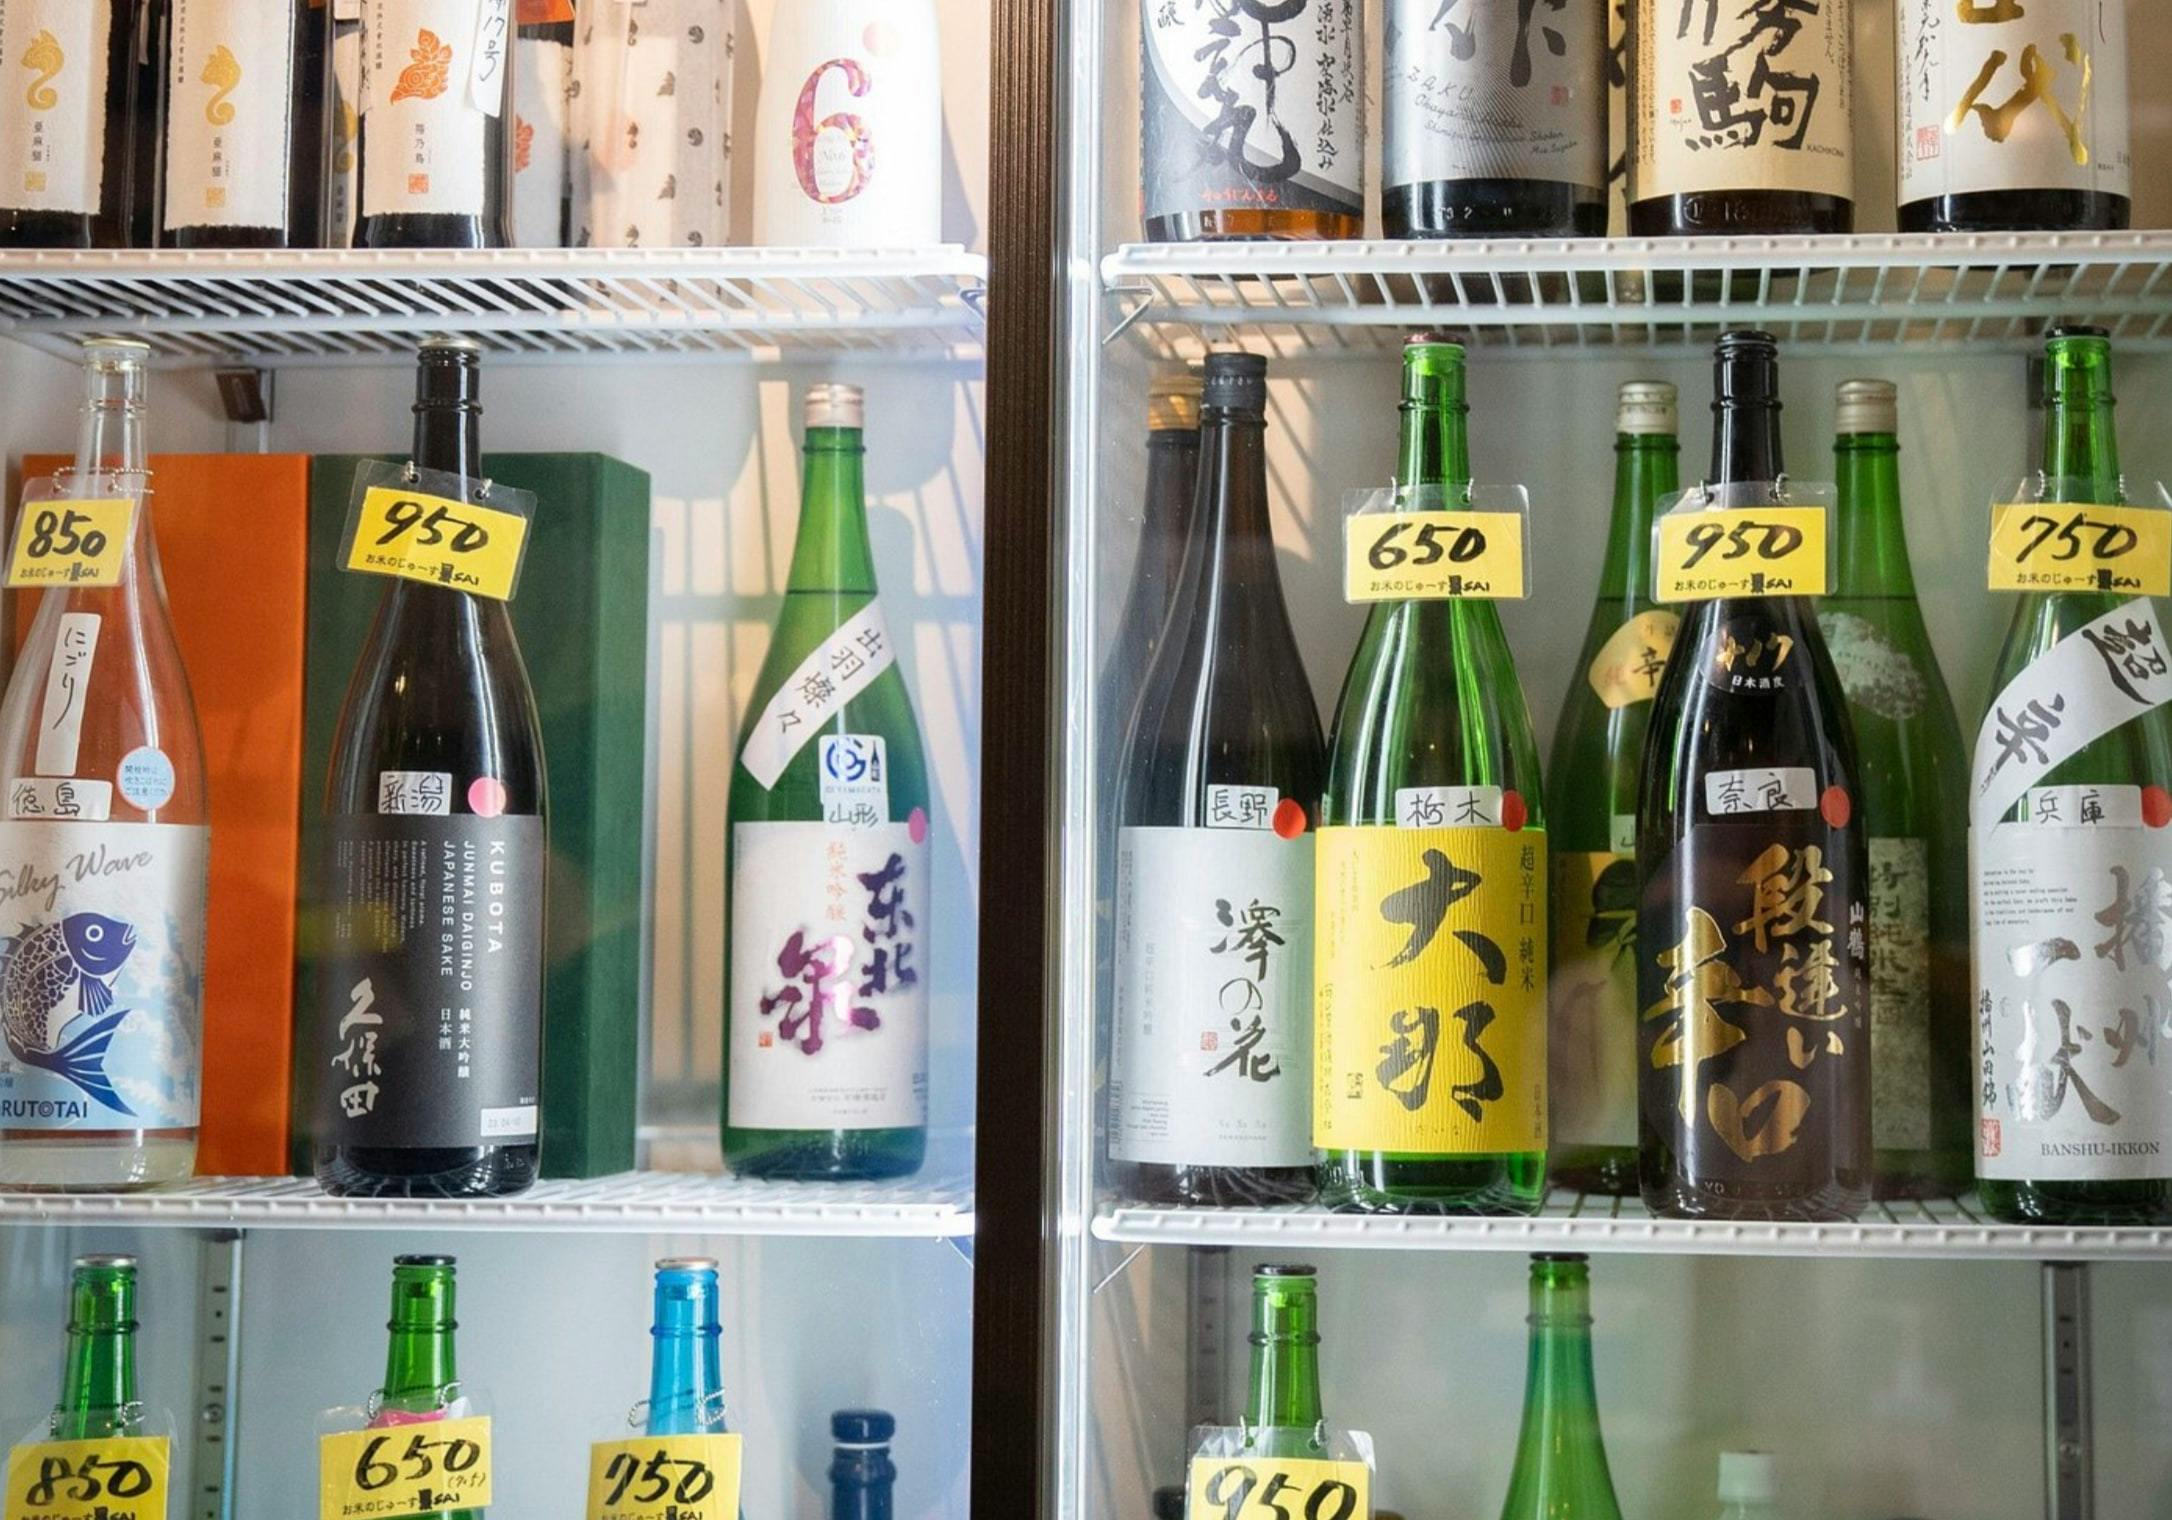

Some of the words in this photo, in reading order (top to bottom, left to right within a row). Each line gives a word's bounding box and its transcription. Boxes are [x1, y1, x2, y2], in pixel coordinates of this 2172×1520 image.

[792, 58, 875, 204] 6
[27, 510, 107, 558] 850
[375, 501, 489, 553] 950
[1369, 522, 1487, 570] 650
[1681, 520, 1803, 570] 950
[2015, 513, 2138, 563] 750
[53, 627, 86, 730] にごり
[828, 803, 879, 828] 山形
[1211, 788, 1268, 826] 長野
[1405, 790, 1492, 828] 栃木
[1718, 774, 1794, 814] 奈良
[2035, 789, 2106, 824] 兵庫
[66, 843, 153, 878] Wave
[441, 840, 456, 926] JAPANESE
[462, 840, 476, 904] JUNMAI
[1519, 844, 1536, 924] 超辛口
[488, 840, 505, 953] KUBOTA
[440, 934, 454, 976] SAKE
[460, 912, 475, 991] DAIGINJO
[1518, 936, 1536, 994] 純米
[1203, 898, 1286, 1083] 澤の花
[1374, 848, 1508, 1123] 大那
[331, 977, 384, 1118] 久保田
[439, 1008, 452, 1050] 日本酒
[458, 1008, 471, 1078] 純米大吟醸
[2041, 1141, 2160, 1157] BANSHU-IKKON
[26, 1454, 153, 1506] 850
[355, 1434, 481, 1491] 650
[605, 1450, 714, 1506] 750
[1205, 1465, 1358, 1520] 950
